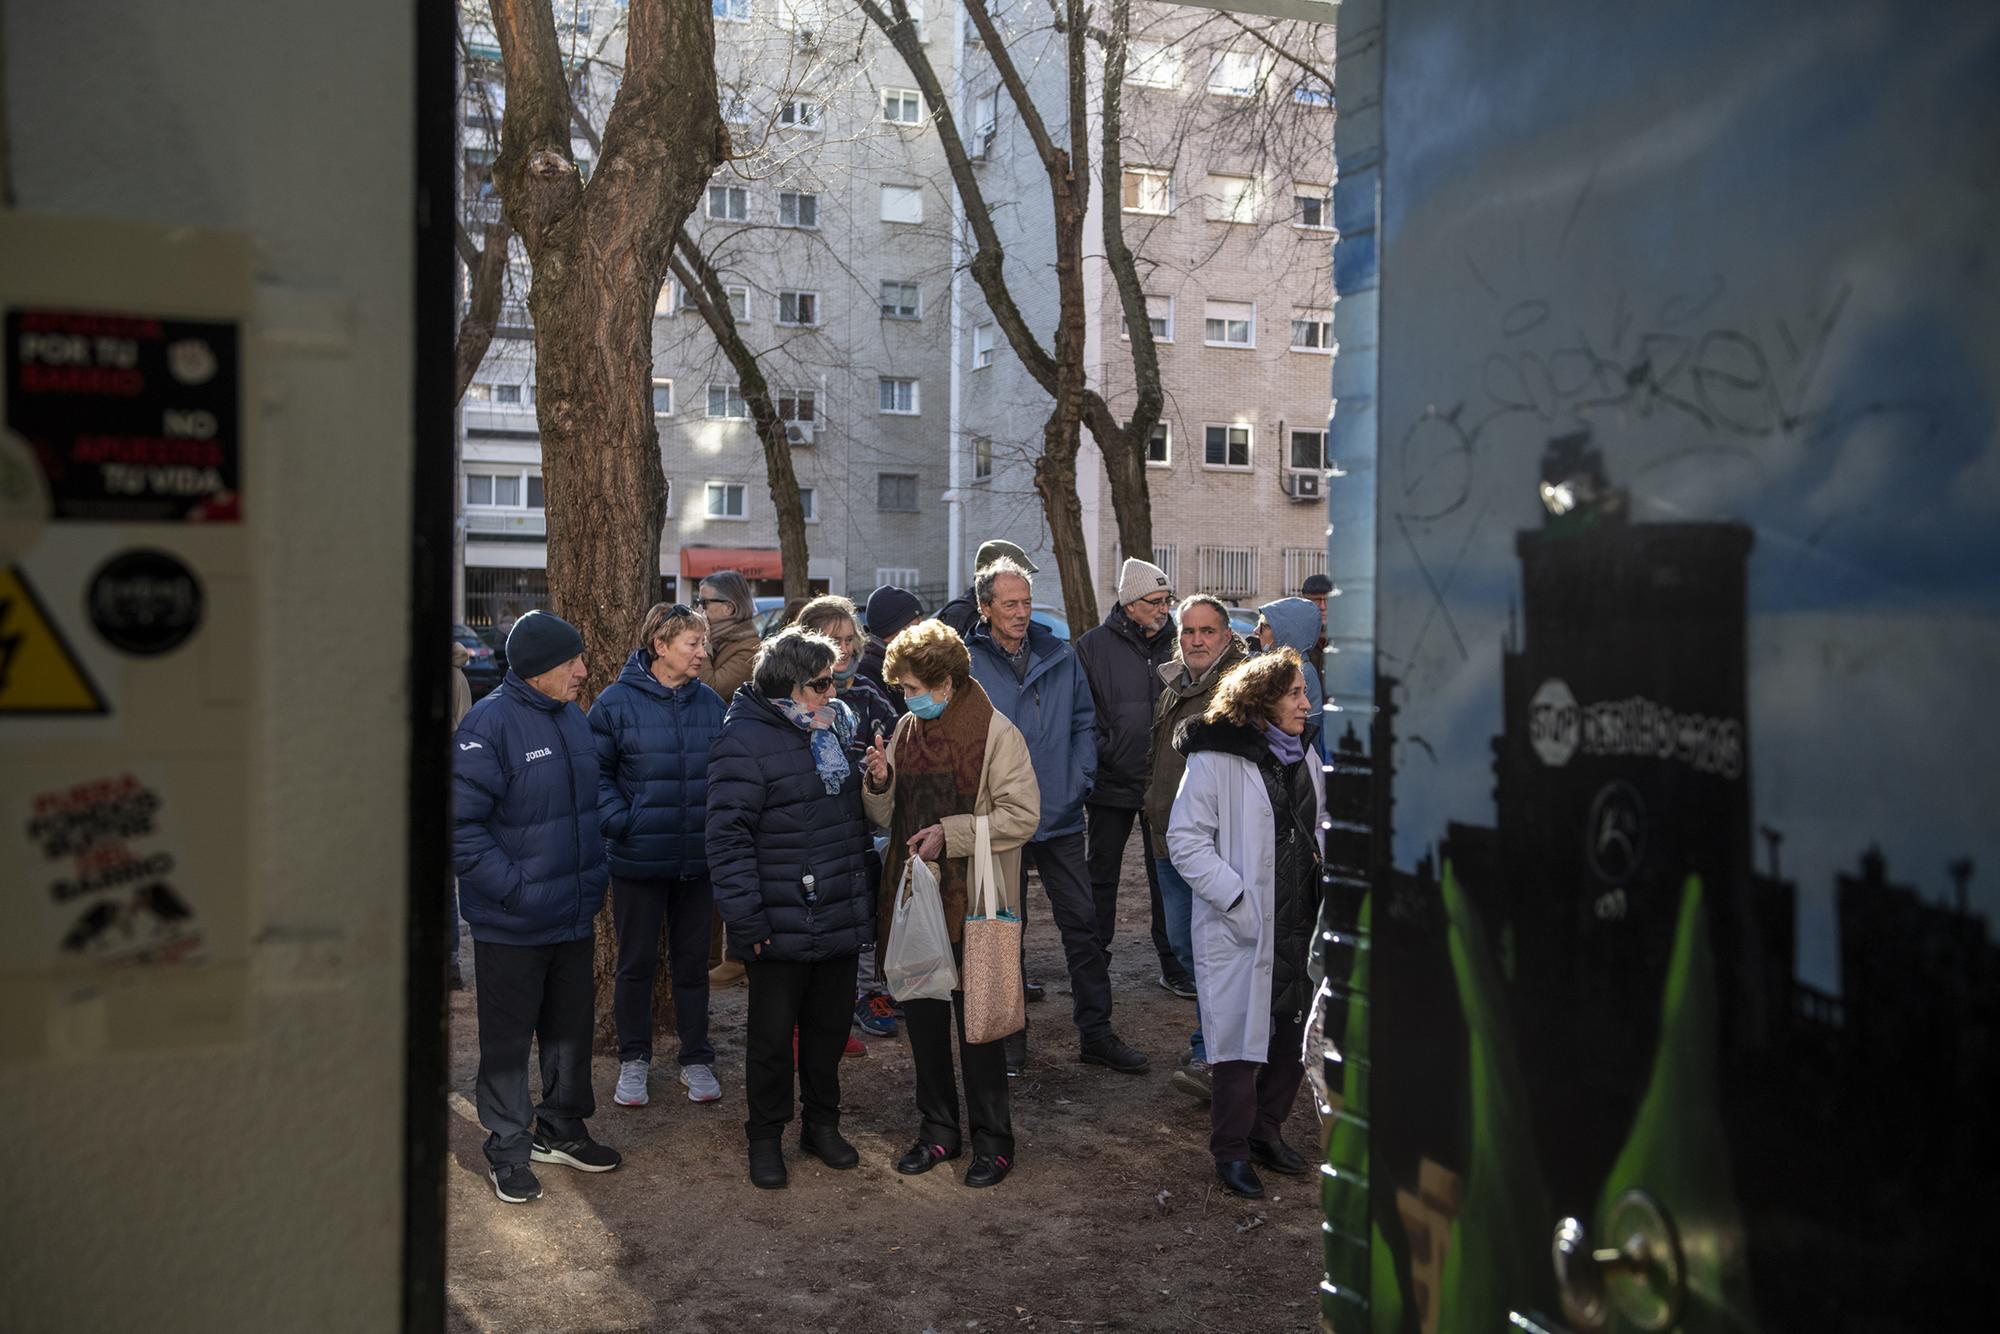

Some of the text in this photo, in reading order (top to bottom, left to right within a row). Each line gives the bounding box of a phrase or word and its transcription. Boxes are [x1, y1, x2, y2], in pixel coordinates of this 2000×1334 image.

[17, 332, 140, 369] POR TU
[162, 408, 219, 441] NO
[97, 462, 226, 497] TU VIDA
